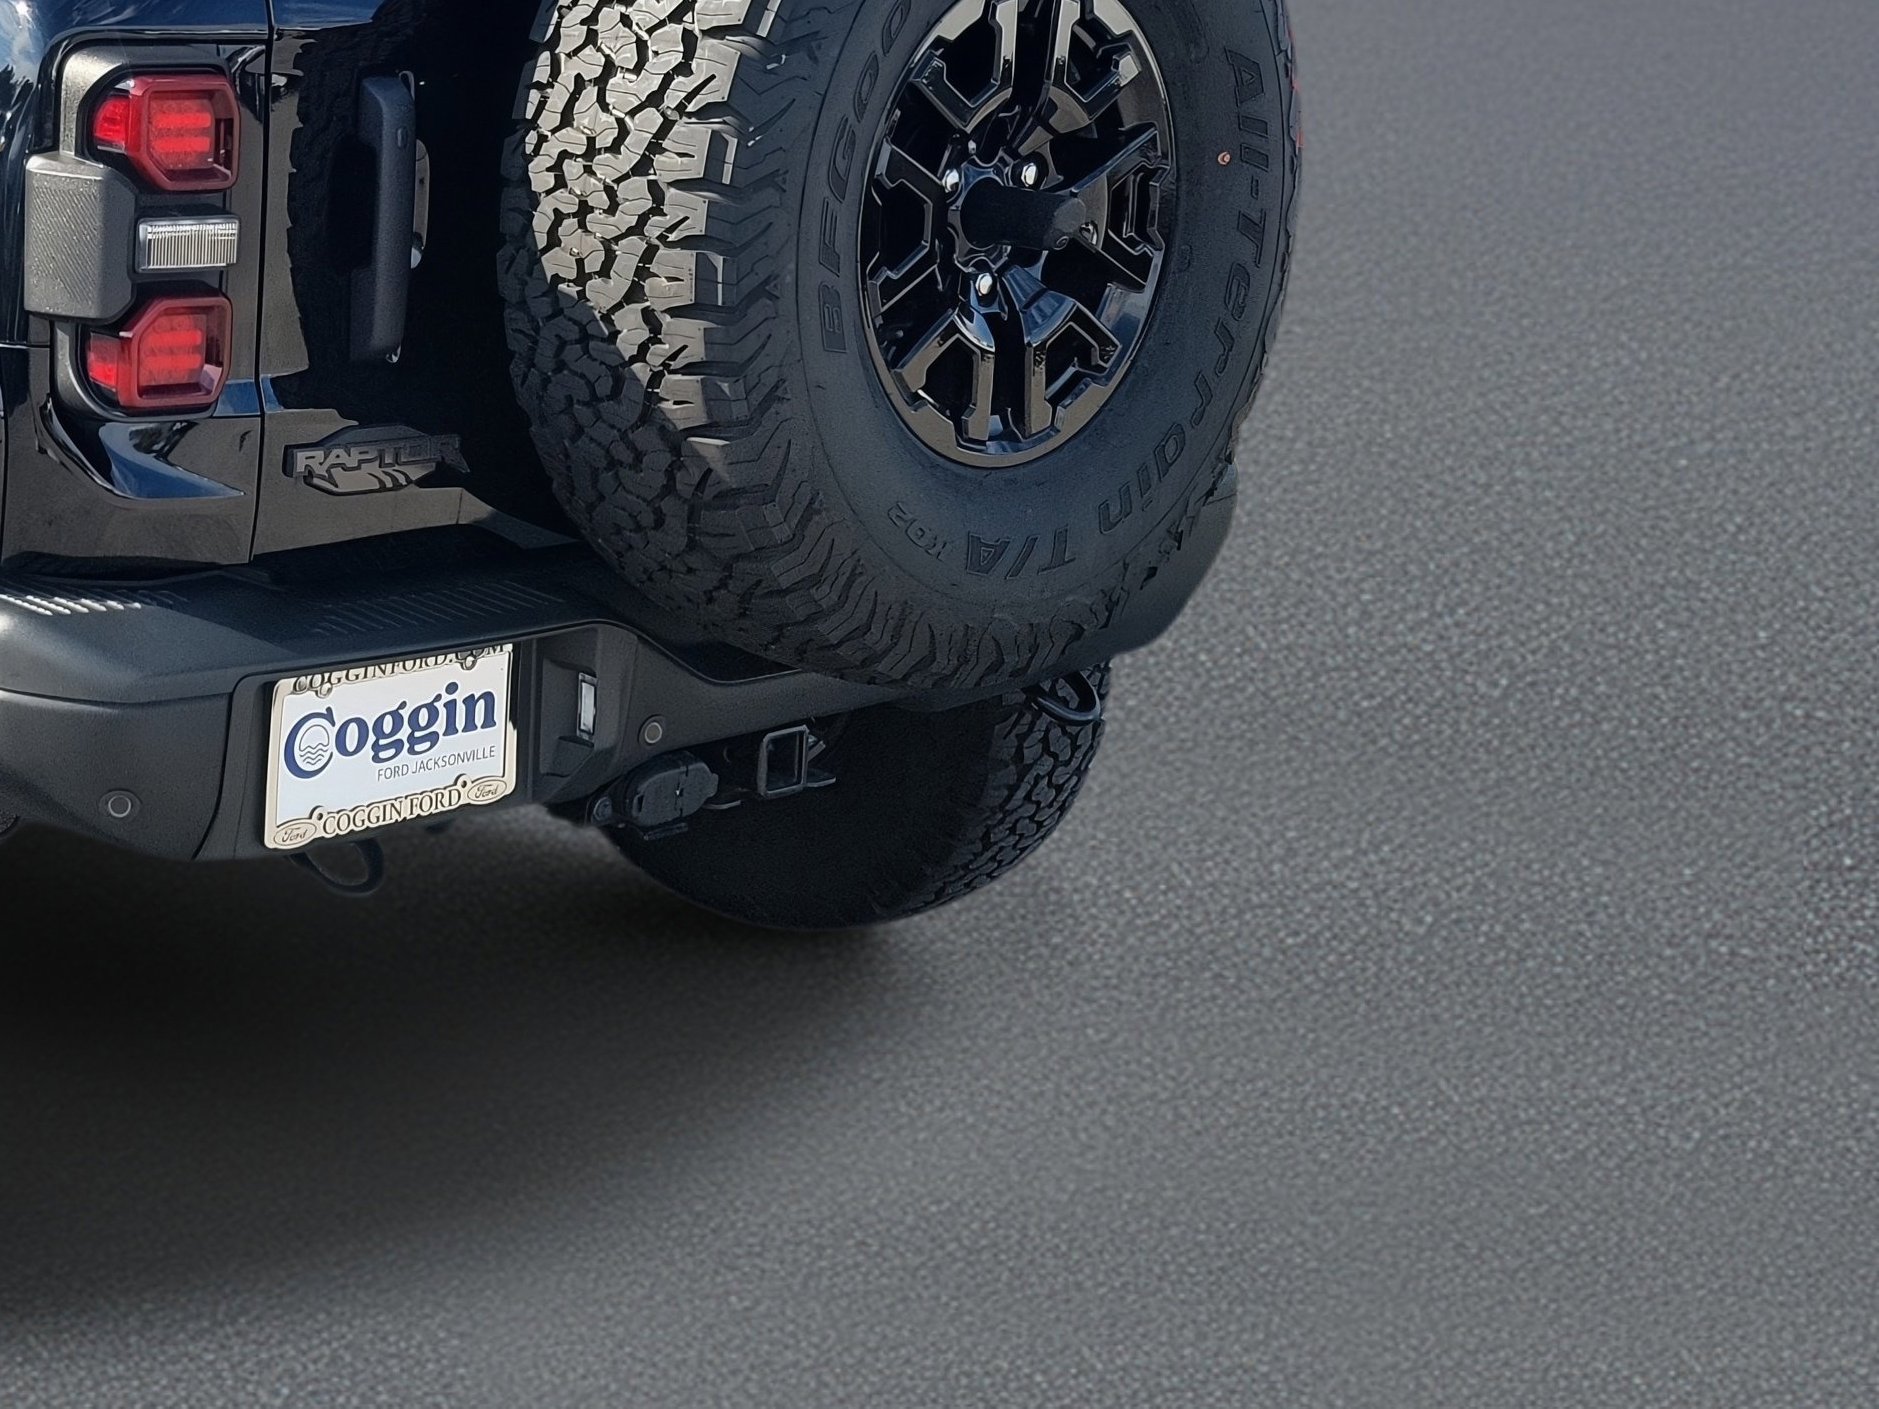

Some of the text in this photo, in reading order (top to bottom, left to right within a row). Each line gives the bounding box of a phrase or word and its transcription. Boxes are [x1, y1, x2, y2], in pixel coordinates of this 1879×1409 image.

[1097, 47, 1269, 535] All-Terrain
[296, 434, 470, 477] RAPTOR
[965, 523, 1076, 581] T/A
[283, 681, 497, 780] Coggin
[377, 746, 496, 781] FORD JACKSONVILLE
[281, 827, 308, 841] Ford
[322, 787, 462, 835] COGGIN FORD
